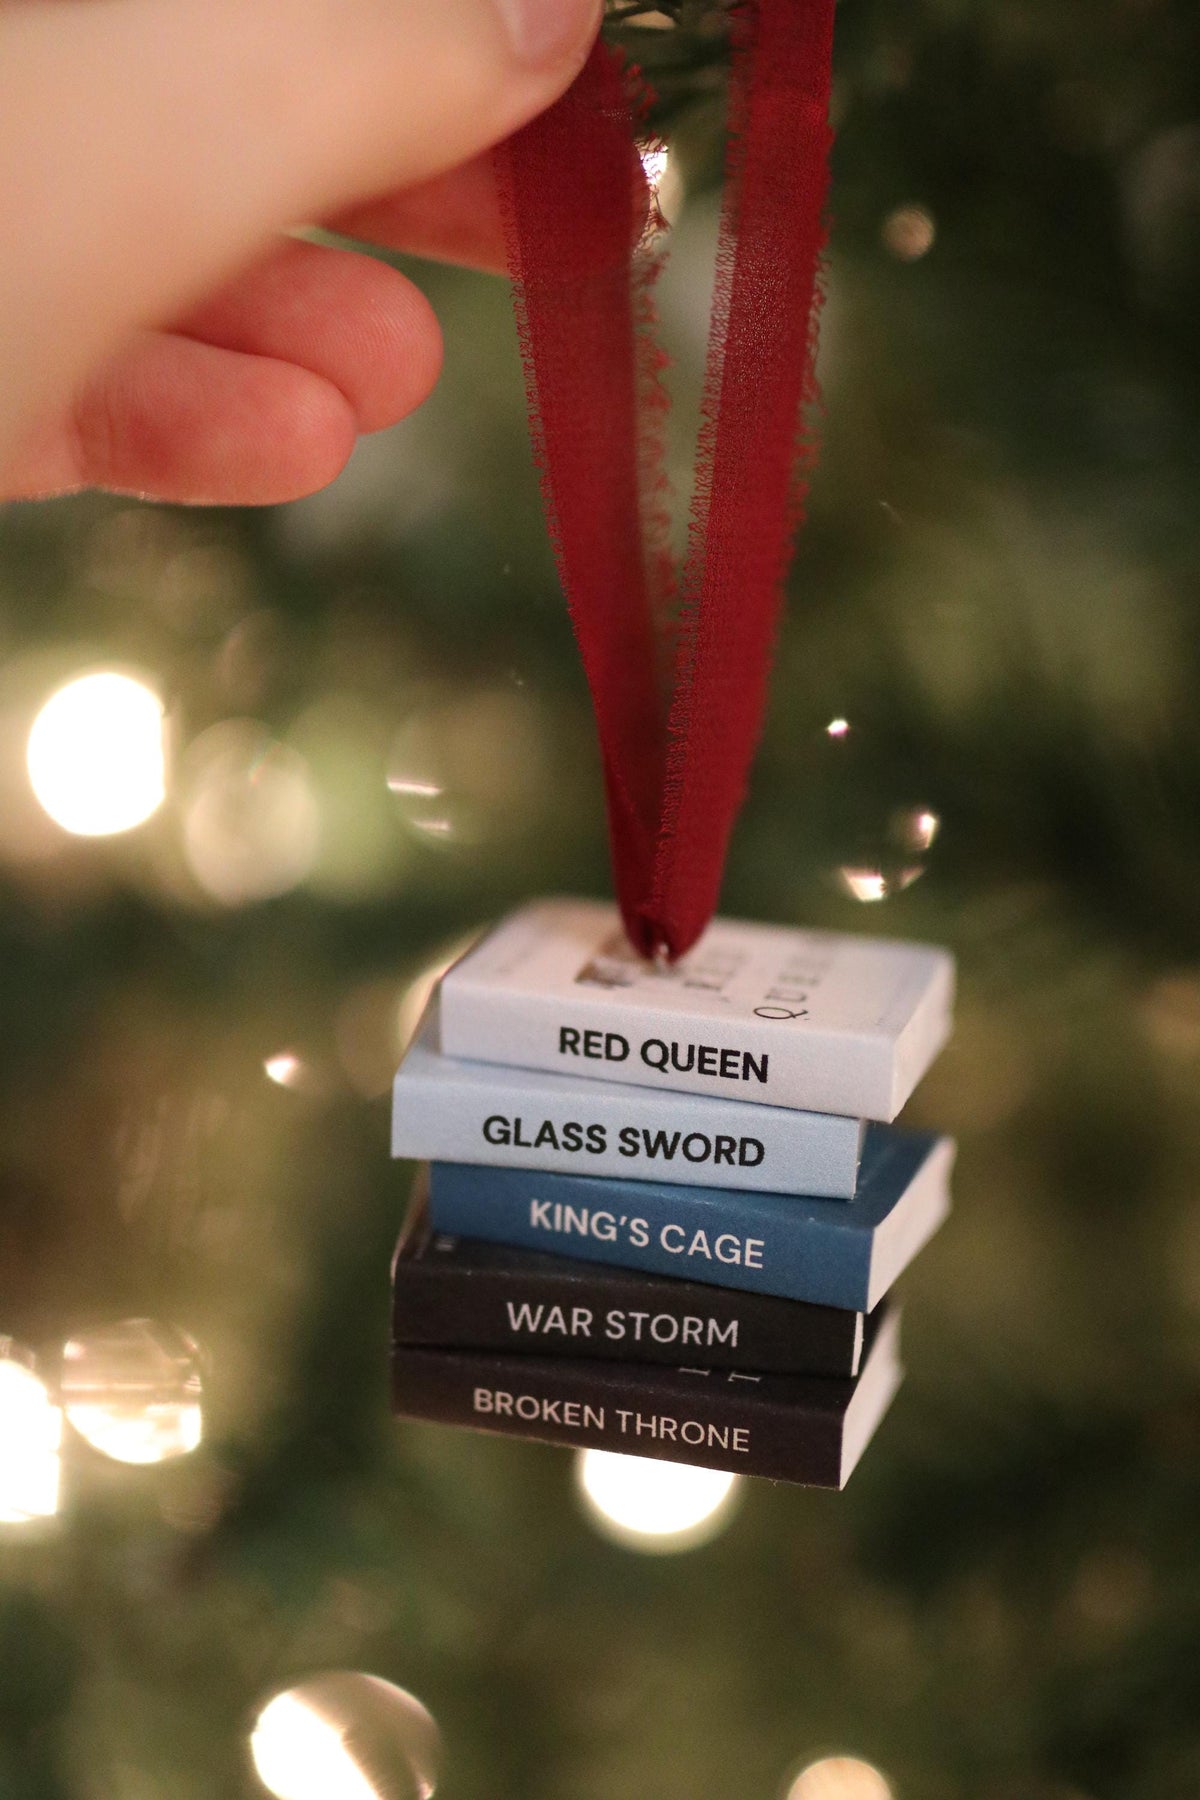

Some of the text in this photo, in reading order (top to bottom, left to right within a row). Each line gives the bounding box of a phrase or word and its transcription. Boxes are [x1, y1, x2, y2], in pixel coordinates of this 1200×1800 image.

[559, 1026, 769, 1083] RED QUEEN
[482, 1115, 766, 1167] GLASS SWORD
[530, 1199, 765, 1268] KING'S CAGE
[507, 1302, 739, 1347] WAR STORM
[474, 1387, 750, 1452] BROKEN THRONE
